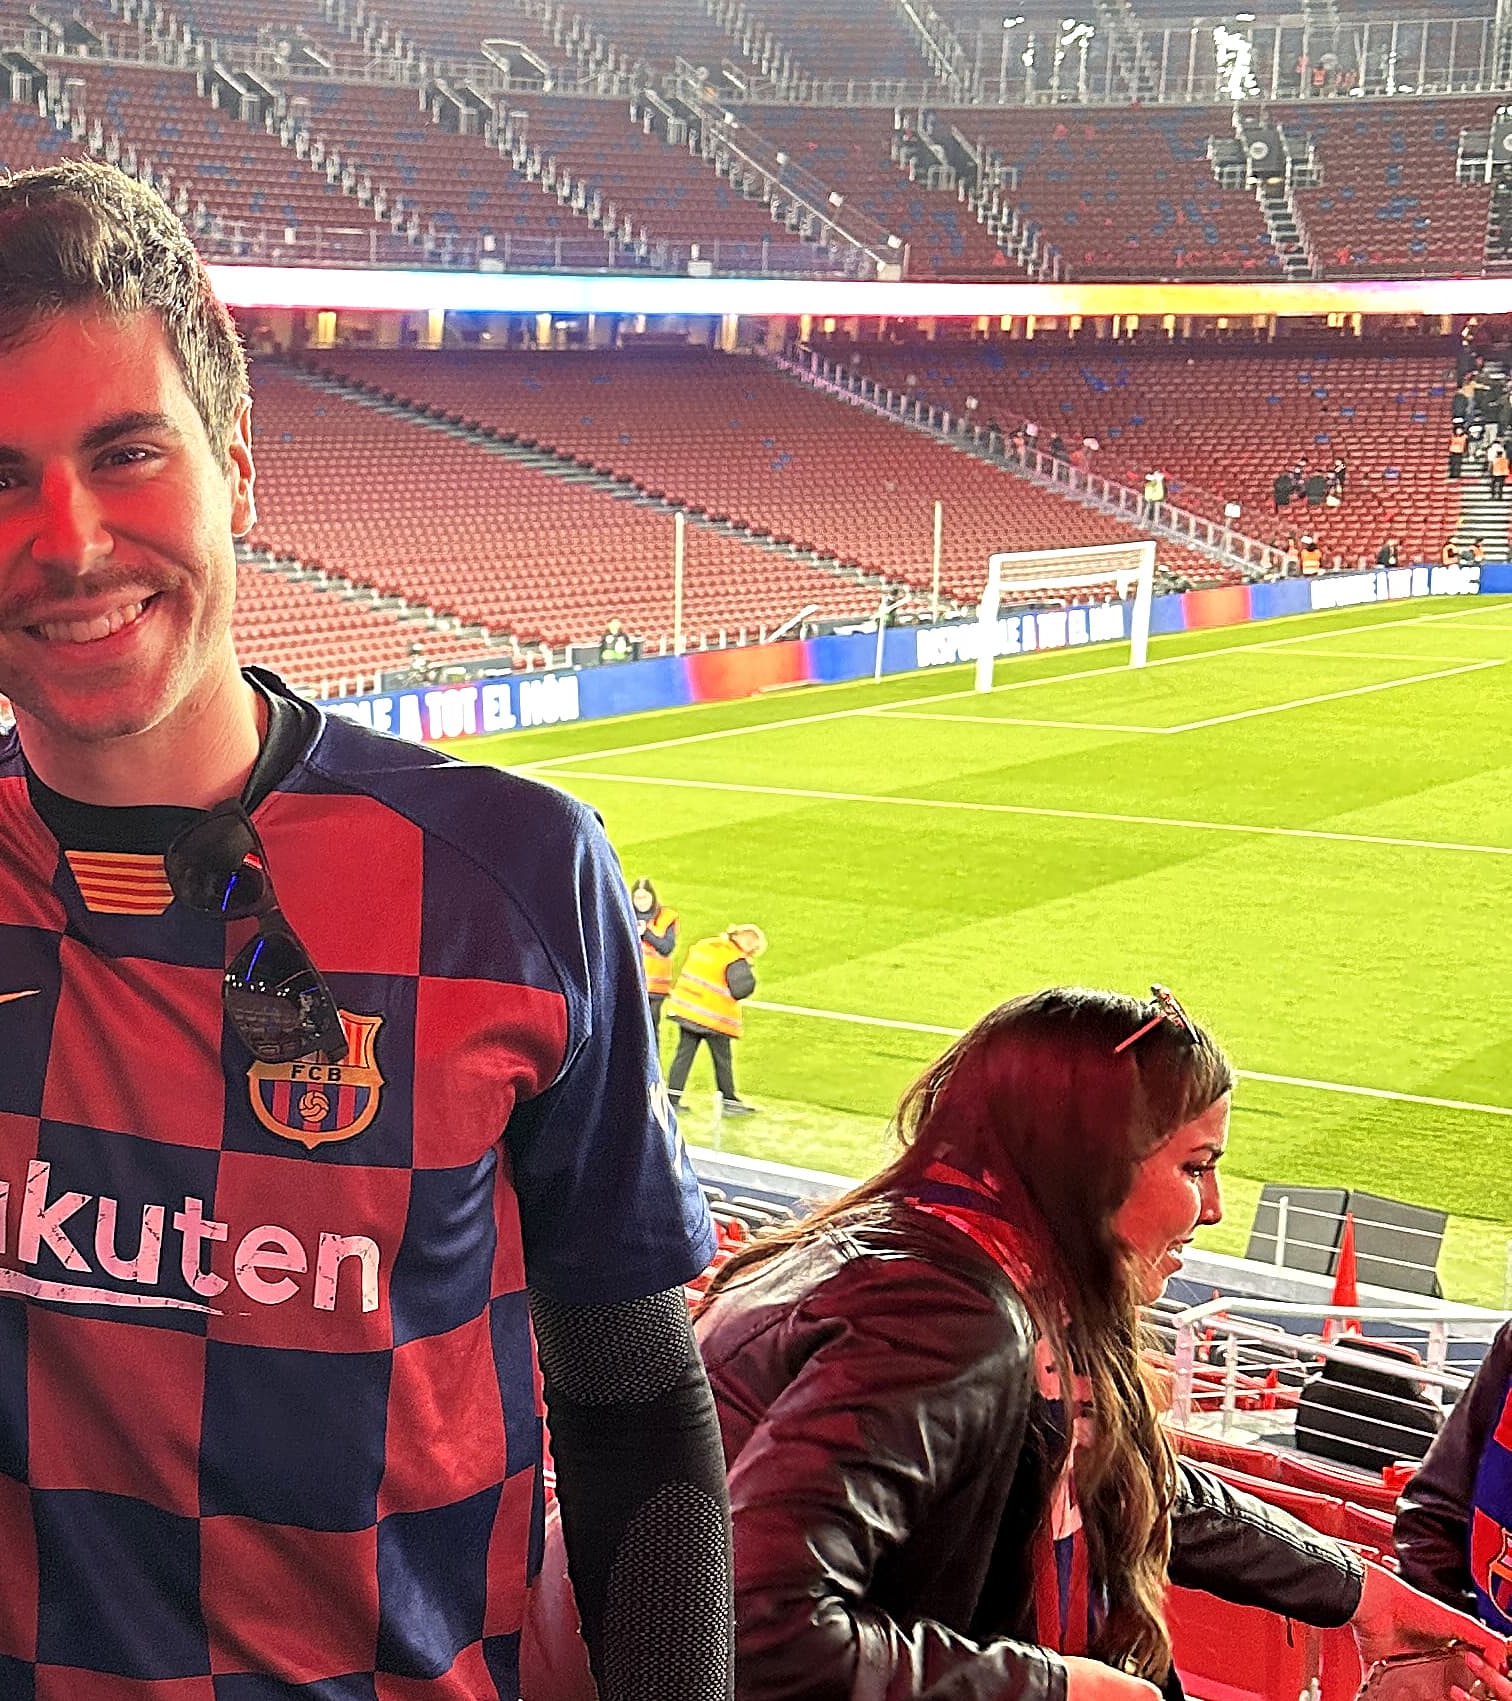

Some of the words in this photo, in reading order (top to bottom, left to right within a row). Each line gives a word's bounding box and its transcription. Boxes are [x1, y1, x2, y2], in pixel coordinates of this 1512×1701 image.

[425, 687, 477, 739] TOT
[483, 684, 516, 732] EL
[291, 1065, 342, 1082] FCB
